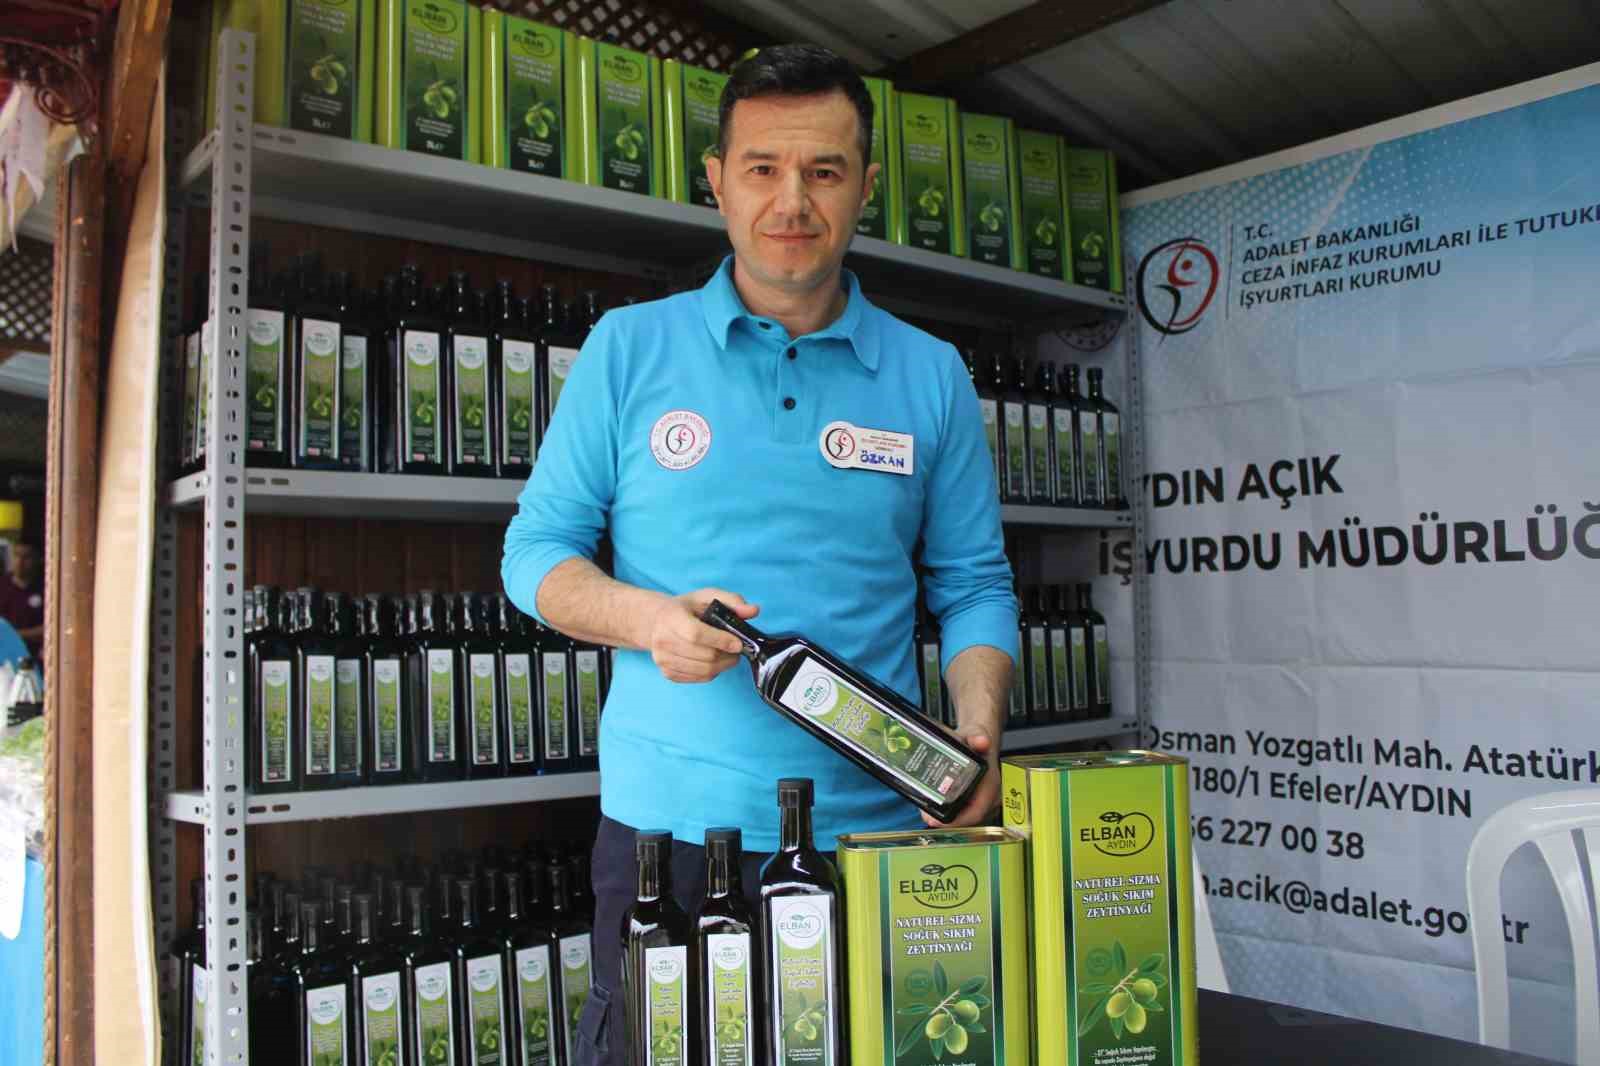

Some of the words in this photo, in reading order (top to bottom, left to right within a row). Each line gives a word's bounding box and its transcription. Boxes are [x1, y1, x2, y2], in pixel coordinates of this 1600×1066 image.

[1242, 236, 1311, 264] ADALET
[1315, 213, 1421, 249] BAKANLIĞI
[1244, 223, 1273, 241] T.C.
[1242, 265, 1286, 285] CEZA
[1290, 253, 1343, 277] İNFAZ
[1348, 230, 1470, 267] KURUMLARI
[1478, 223, 1509, 243] İLE
[1239, 277, 1343, 310] İŞYURTLARI
[1349, 260, 1441, 291] KURUMU
[861, 450, 905, 469] ÖZKAN
[1143, 466, 1225, 508] DIN
[1237, 454, 1344, 510] AÇIK
[1245, 729, 1363, 767] Yozgatlı
[1373, 738, 1453, 771] Mah.
[1270, 772, 1472, 818] Efeler/AYDIN
[1080, 825, 1136, 842] ELBAN
[1106, 840, 1136, 849] AYDIN
[1221, 818, 1272, 848] 227
[1281, 824, 1318, 854] 00
[1326, 830, 1365, 860] 38
[899, 877, 959, 894] ELBAN
[1074, 876, 1124, 889] NATUREL
[896, 914, 945, 928] NATUREL
